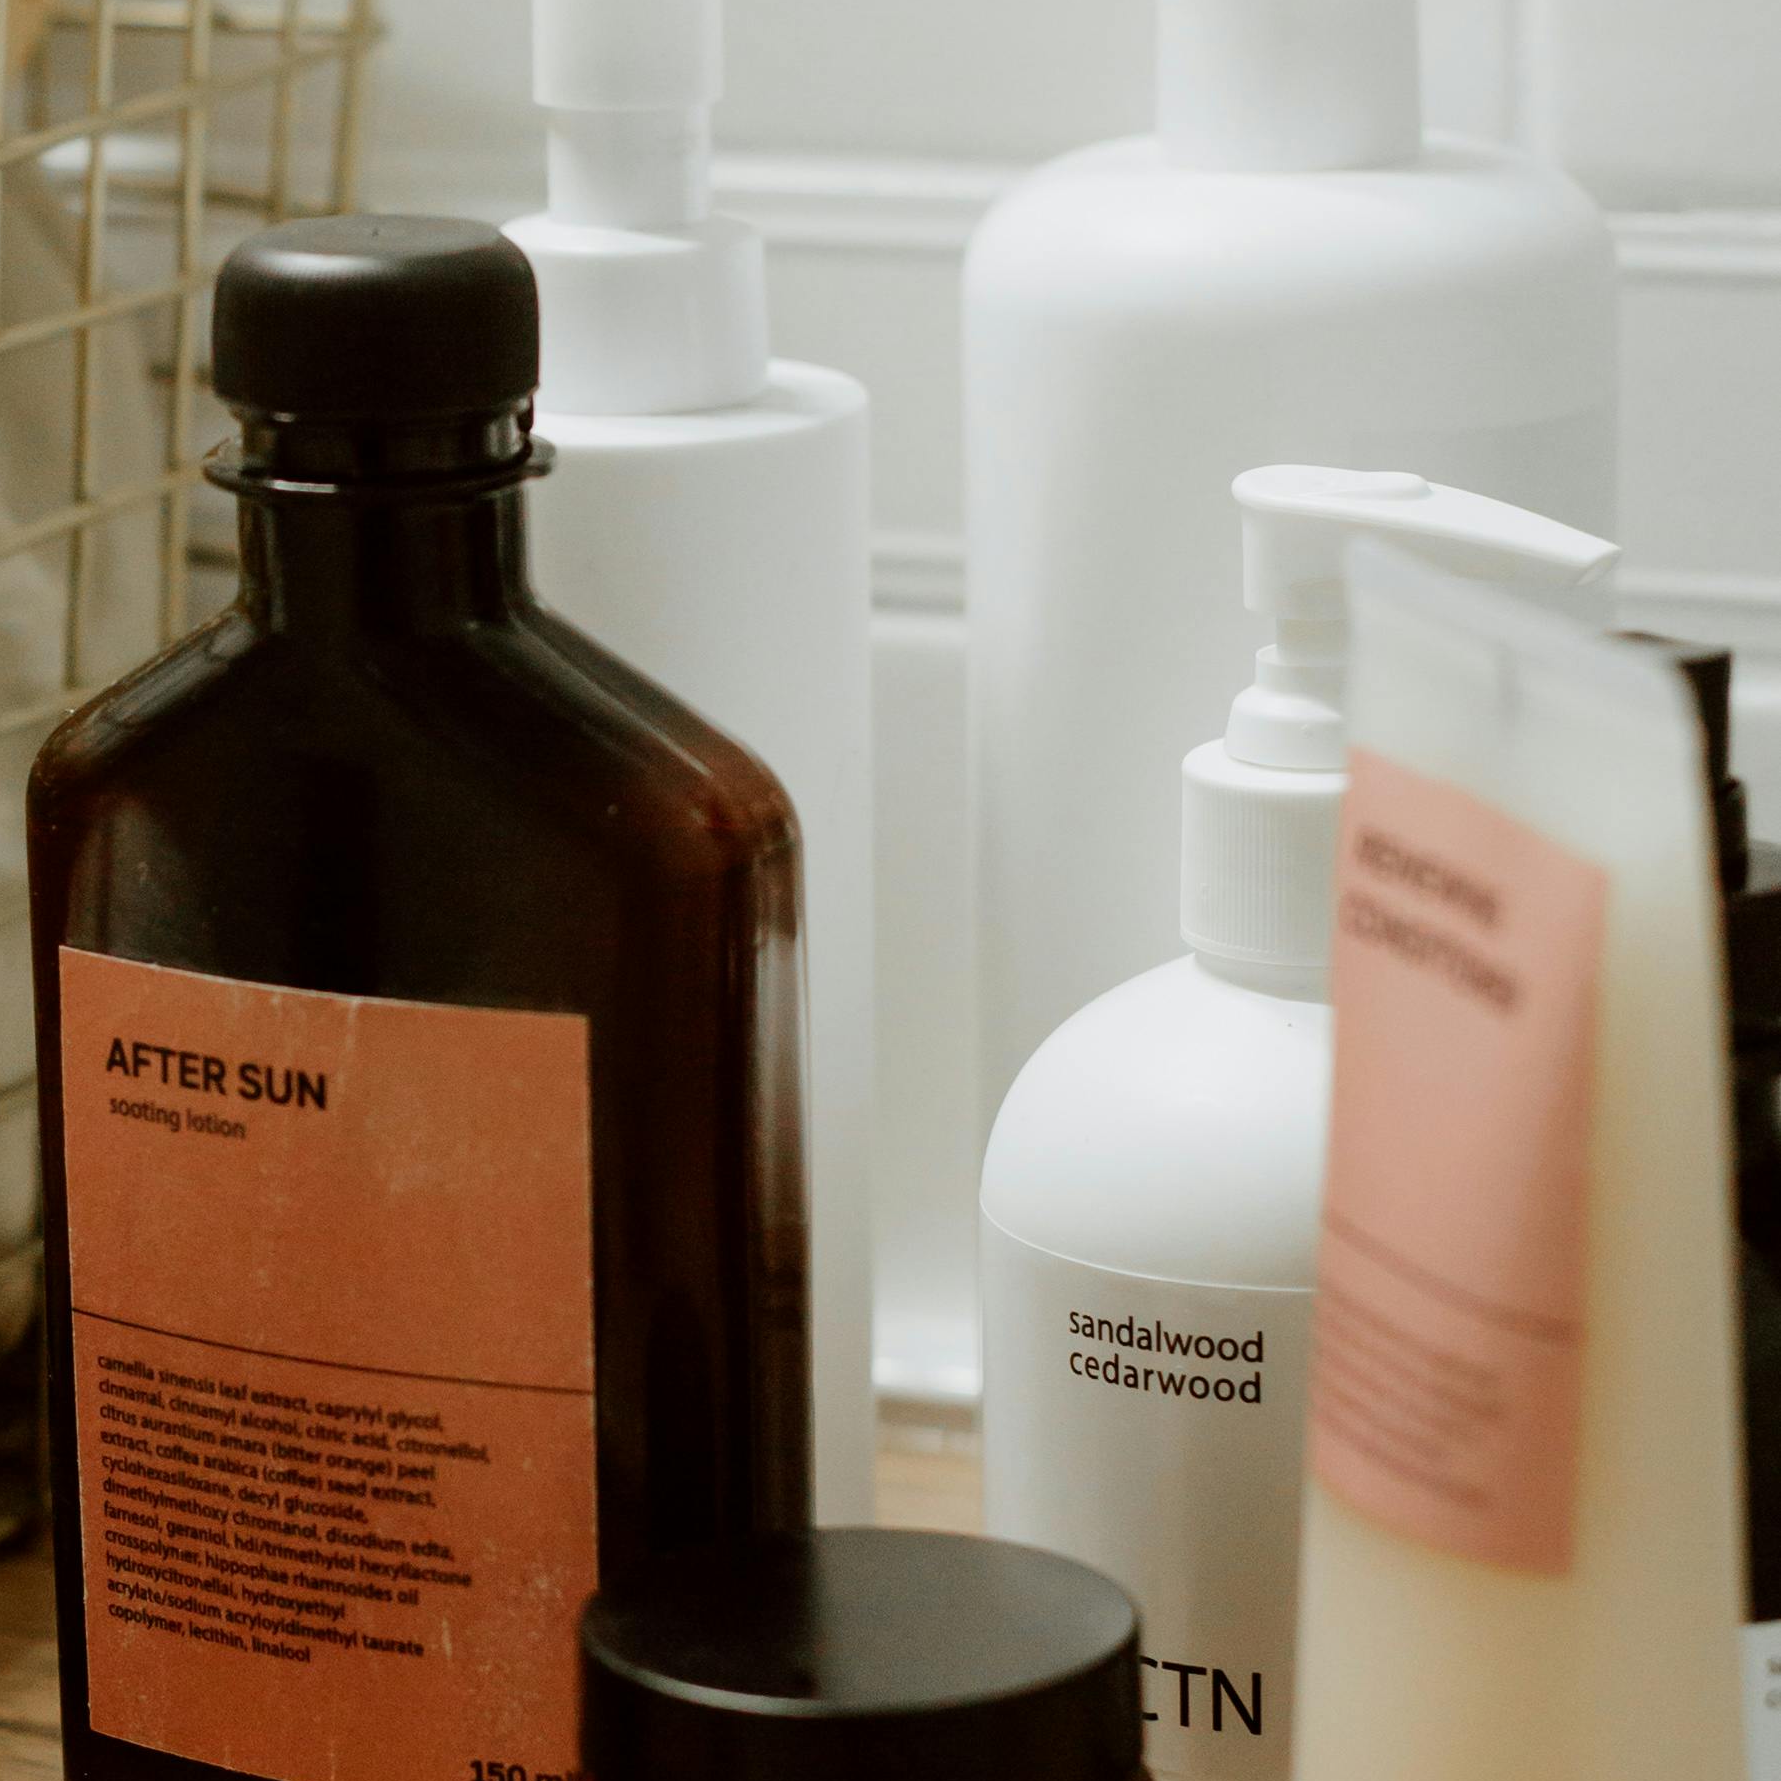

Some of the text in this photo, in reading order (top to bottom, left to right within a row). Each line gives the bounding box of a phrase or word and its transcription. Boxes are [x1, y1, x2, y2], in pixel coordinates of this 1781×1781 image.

[106, 1037, 327, 1111] AFTER SUN
[109, 1096, 246, 1140] sooting lotion
[1069, 1308, 1265, 1364] sandalwood
[98, 1355, 155, 1381] camellia
[159, 1369, 215, 1395] sinensis
[219, 1384, 247, 1400] leaf
[251, 1391, 310, 1413] extract,
[1069, 1348, 1263, 1405] cedarwood
[99, 1379, 165, 1410] cinnamal,
[169, 1396, 236, 1425] cinnamyl
[241, 1414, 301, 1438] alcohol,
[306, 1425, 347, 1444] citric
[99, 1404, 137, 1425] citrus
[141, 1416, 216, 1444] aurantium
[220, 1434, 267, 1456] amara
[397, 1463, 436, 1480] peel
[101, 1431, 153, 1456] extract,
[156, 1445, 200, 1466] coffea
[204, 1456, 258, 1479] arabica
[263, 1467, 322, 1490] (coffee)
[327, 1478, 365, 1498] seed
[103, 1478, 228, 1524] dimethylmethoxy
[326, 1526, 406, 1554] disodium
[238, 1486, 279, 1510] decyl
[166, 1520, 230, 1548] geraniol,
[205, 1553, 288, 1585] hippophae
[293, 1570, 393, 1601] rhamnoides
[397, 1589, 419, 1605] oil
[242, 1585, 345, 1621] hydroxyethyl
[107, 1577, 222, 1619] acrylate/sodium
[363, 1634, 424, 1656] taurate
[109, 1602, 311, 1663] copolymer, lecithin, linalool
